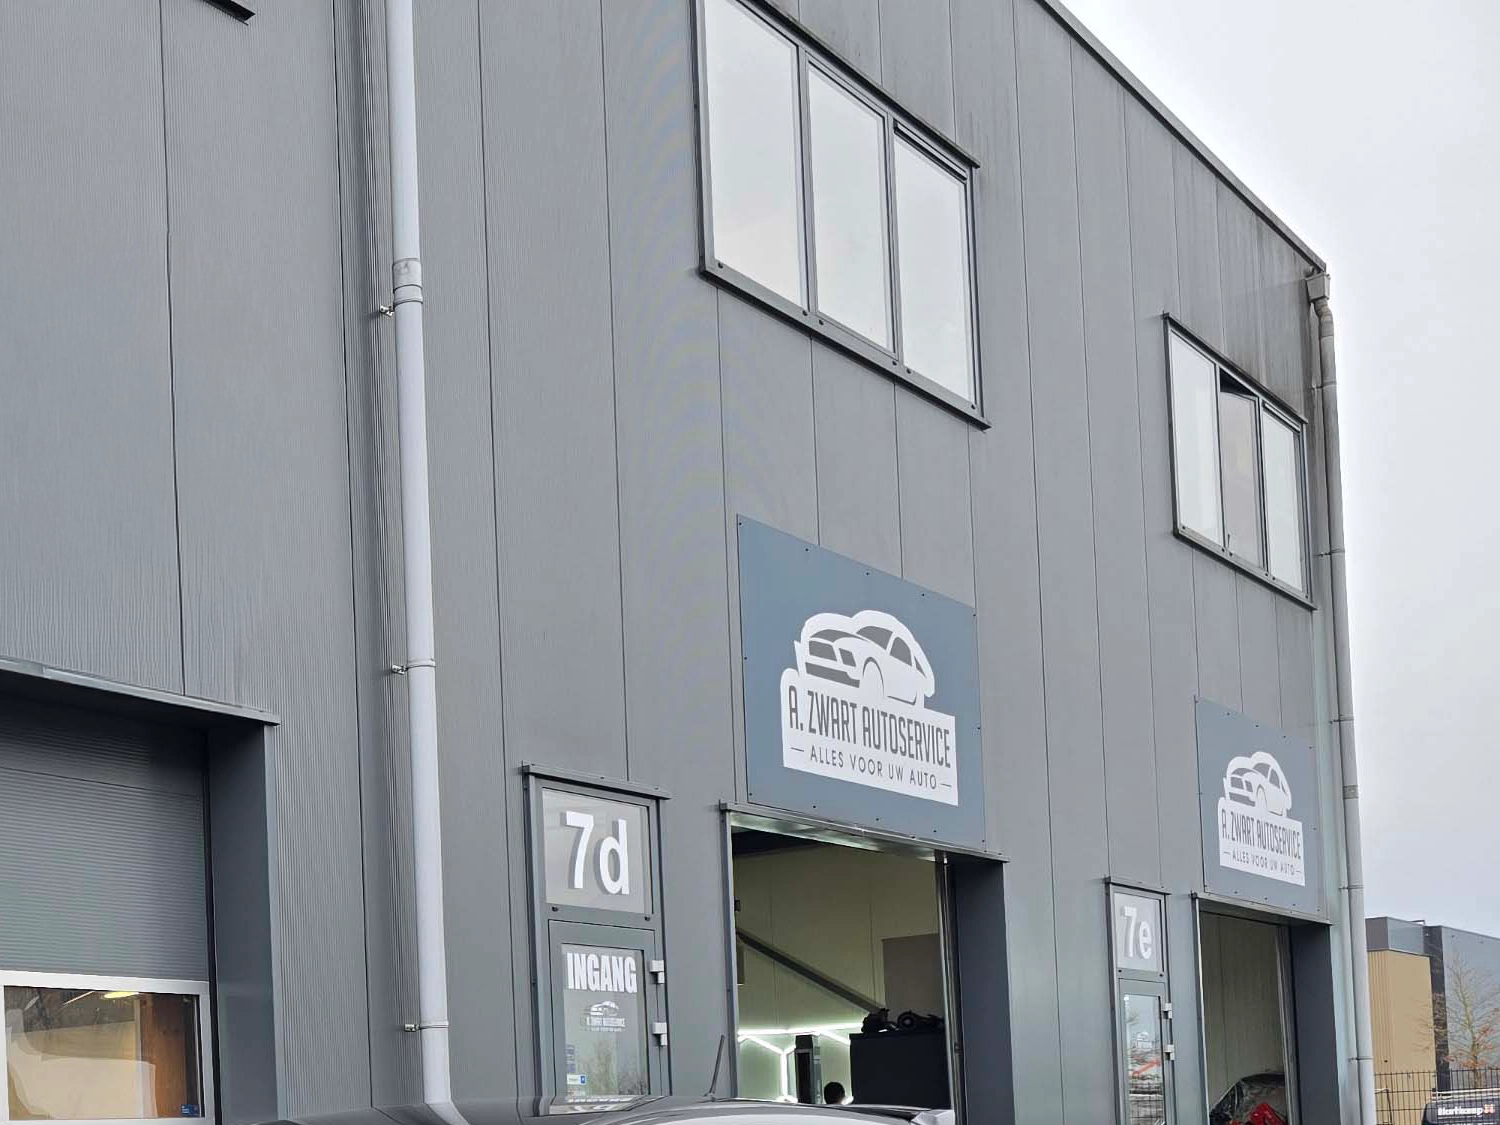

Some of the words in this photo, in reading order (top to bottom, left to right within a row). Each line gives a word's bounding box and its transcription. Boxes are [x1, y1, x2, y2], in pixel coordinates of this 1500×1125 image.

[788, 685, 804, 731] A.
[807, 690, 857, 744] ZWART
[862, 706, 951, 768] AUTOSERVICE
[810, 745, 844, 768] ALLES
[850, 755, 883, 777] VOOR
[888, 763, 904, 782] UW
[909, 769, 937, 790] AUTO
[565, 810, 630, 895] 7d
[1231, 811, 1255, 847] ZWART
[1256, 819, 1301, 860] AUTOSERVICE
[1232, 849, 1249, 864] ALLES
[1251, 855, 1268, 869] VOOR
[1280, 862, 1295, 876] AUTO
[1124, 905, 1152, 960] 7e
[566, 952, 638, 994] INGANG
